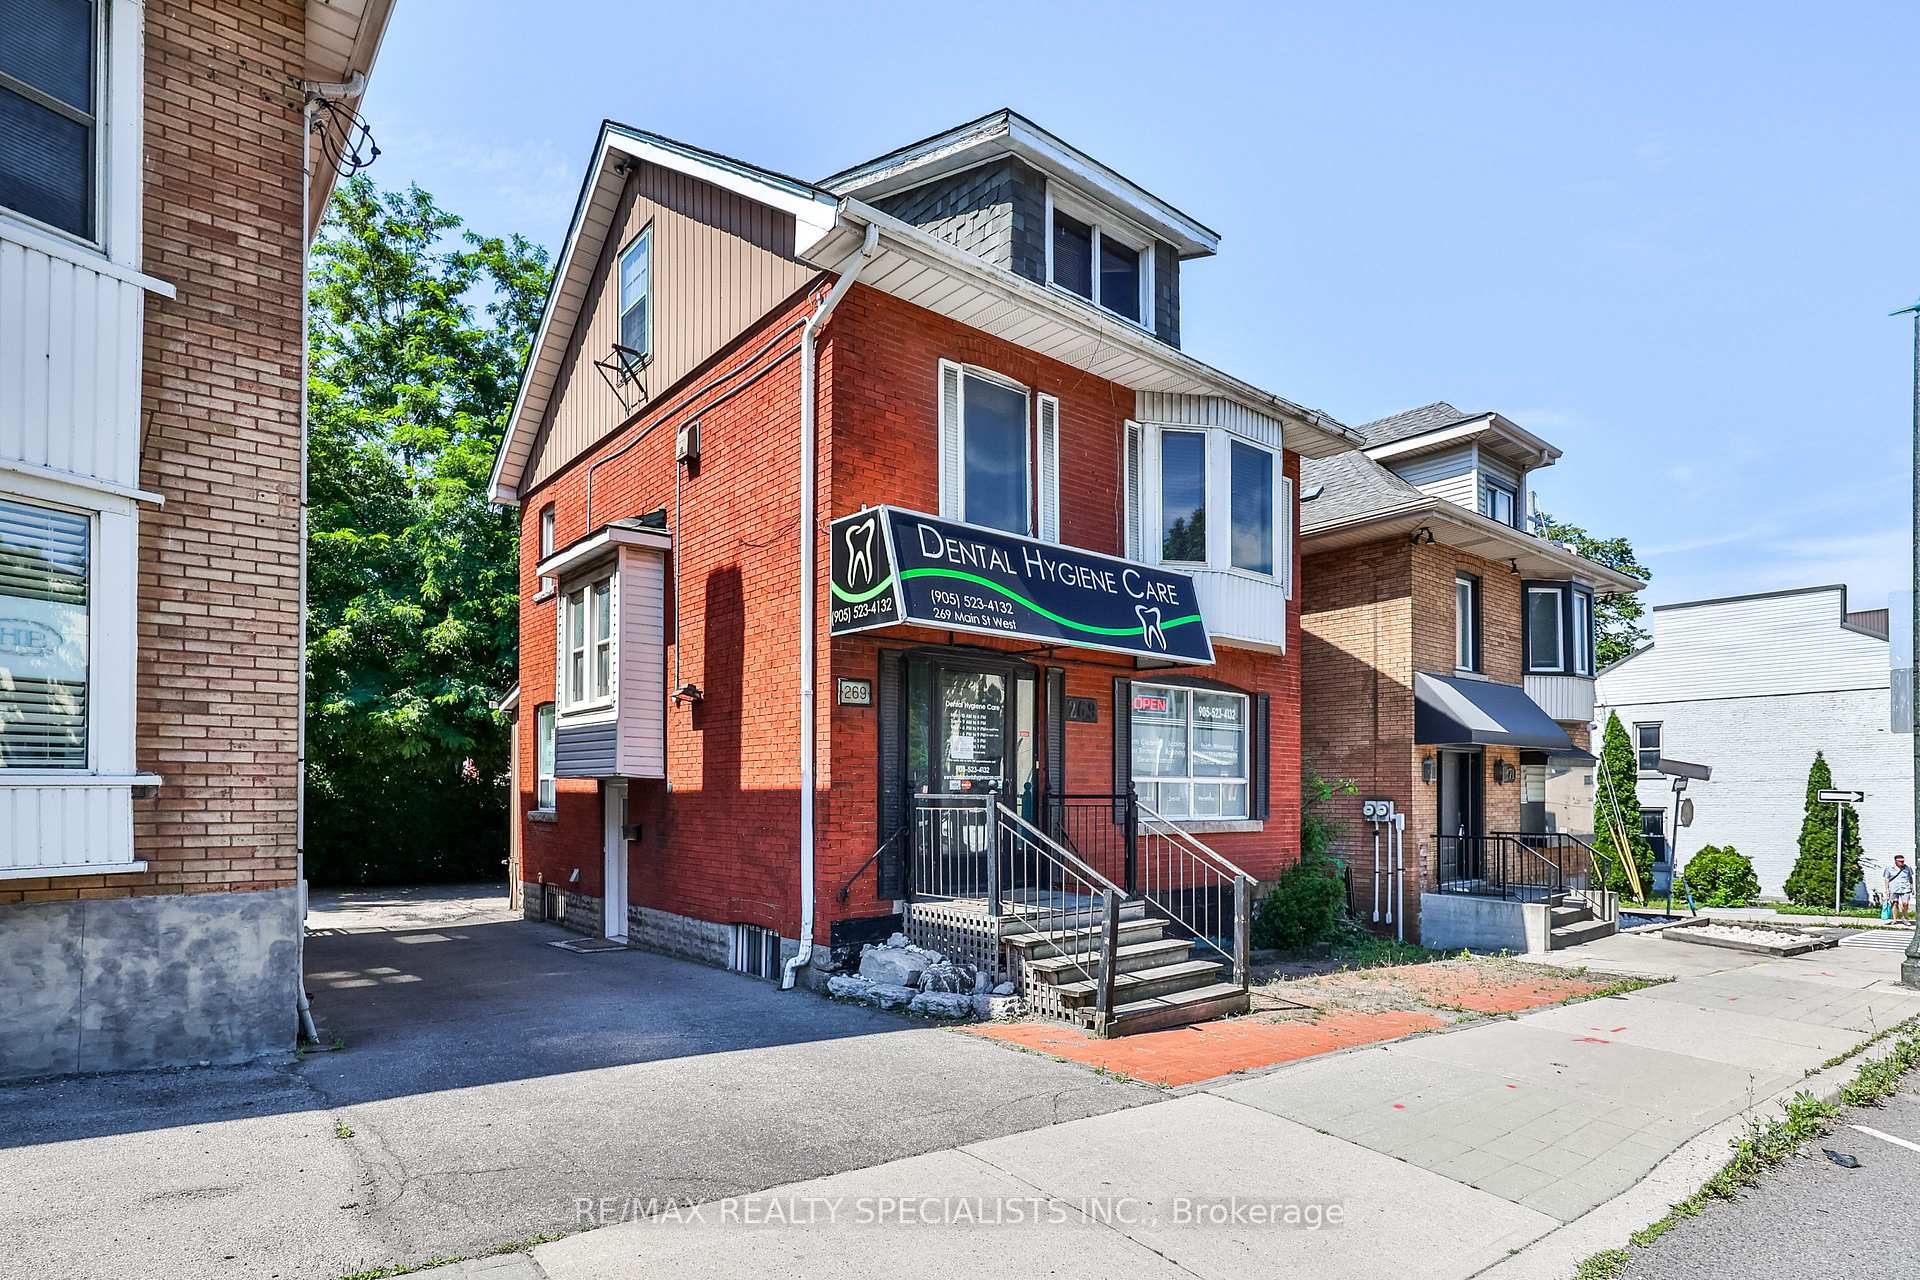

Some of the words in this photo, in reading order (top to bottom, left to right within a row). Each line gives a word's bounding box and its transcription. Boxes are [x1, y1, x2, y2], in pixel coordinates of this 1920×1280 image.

[917, 523, 1018, 575] DENTAL
[1022, 546, 1118, 594] HYGIENE
[1122, 568, 1180, 606] CARE
[931, 589, 961, 609] (905)
[964, 595, 1014, 615] 523-4132
[832, 606, 851, 627] (905)
[853, 597, 892, 619] 523-4132
[933, 607, 952, 620] 269
[954, 611, 980, 625] Main
[981, 614, 991, 627] St
[992, 616, 1017, 630] West
[844, 685, 867, 700] 269
[964, 702, 986, 711] Hygiene
[1133, 697, 1166, 712] OPEN
[1198, 705, 1236, 721] 905-523-4132
